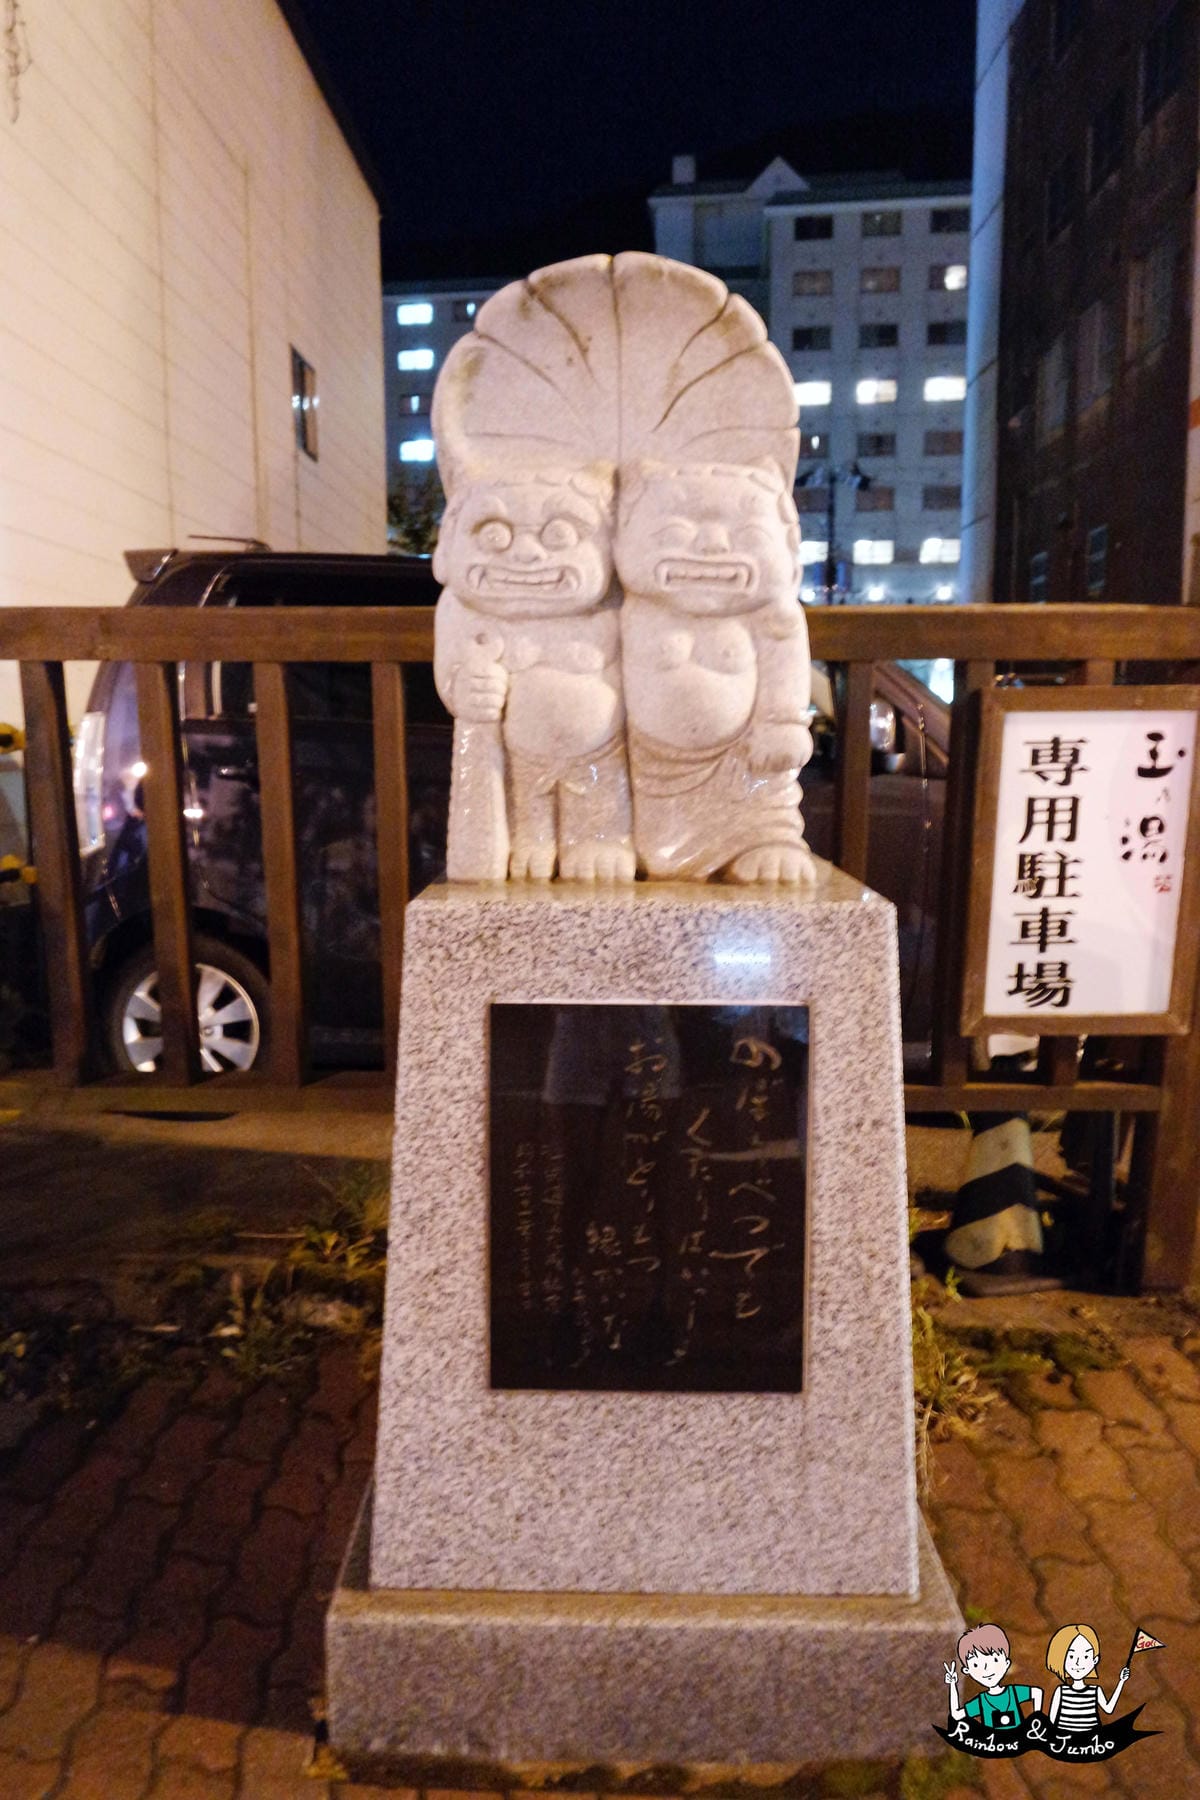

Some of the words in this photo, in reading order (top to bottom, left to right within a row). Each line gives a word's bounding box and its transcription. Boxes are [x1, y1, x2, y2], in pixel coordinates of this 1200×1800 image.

[1004, 735, 1090, 1009] 専用駐車場
